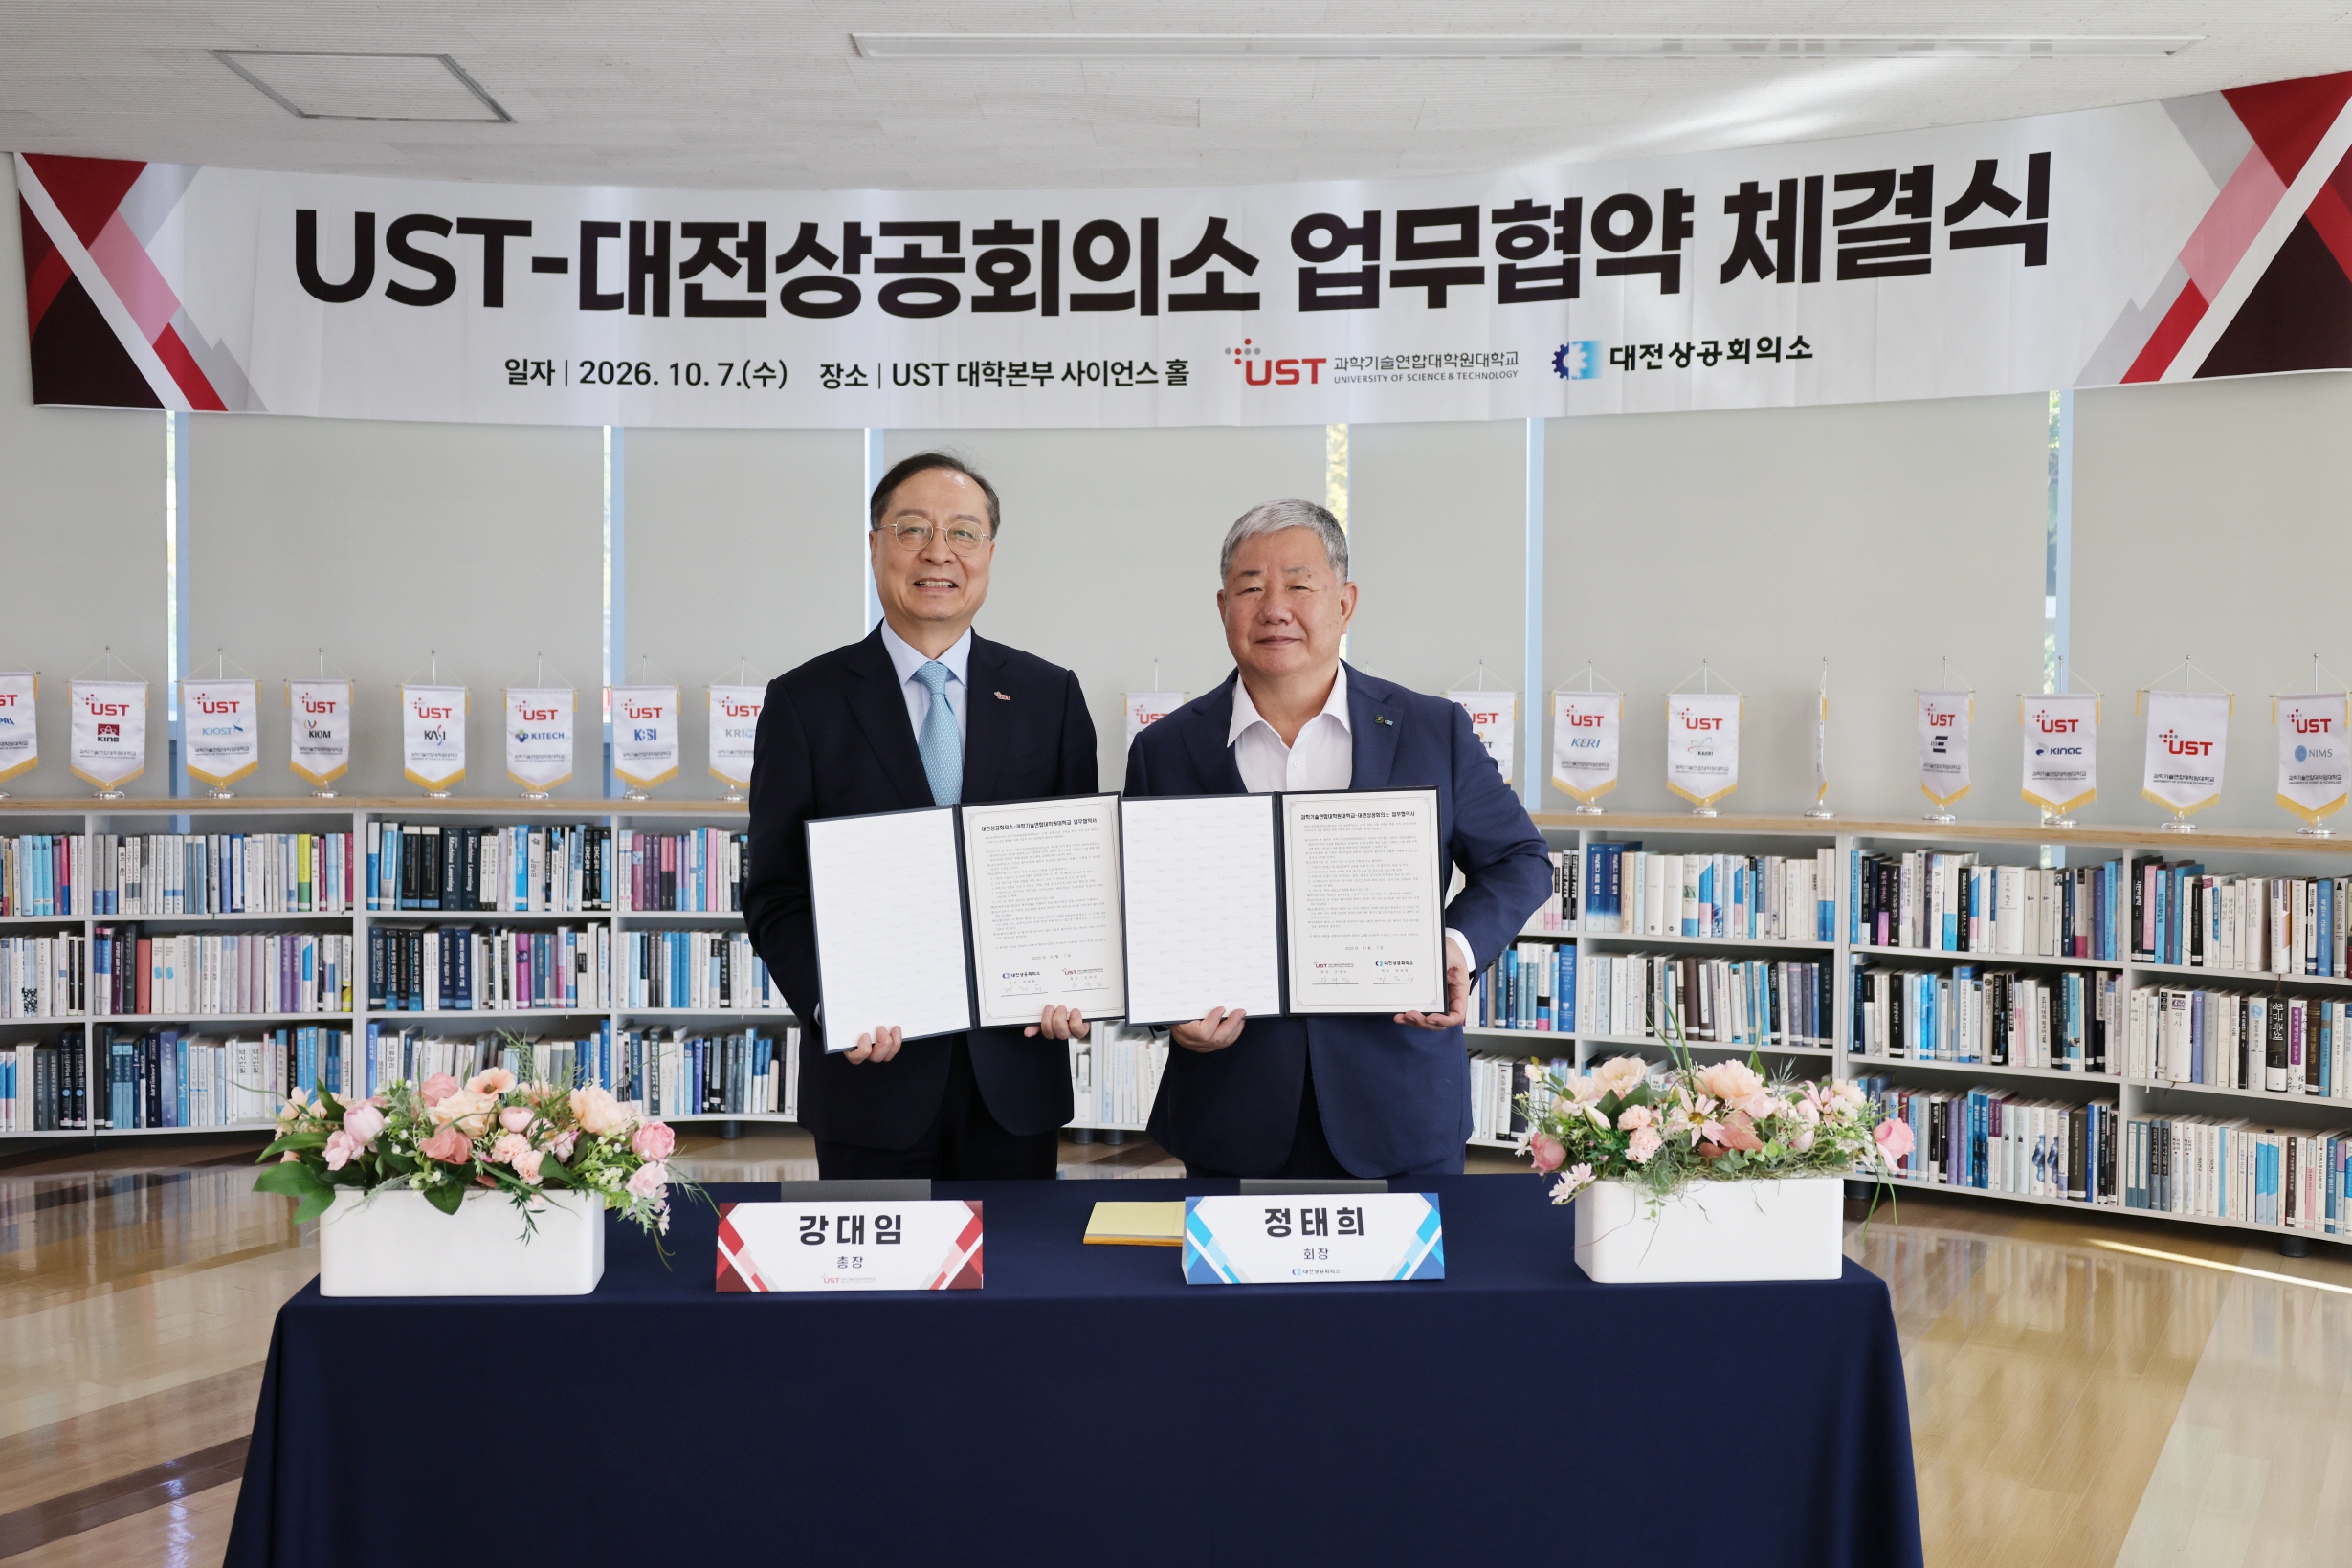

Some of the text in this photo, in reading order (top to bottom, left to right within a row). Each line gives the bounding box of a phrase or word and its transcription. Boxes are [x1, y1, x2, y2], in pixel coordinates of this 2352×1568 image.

[296, 152, 2051, 319] UST-대전상공회의소 업무협약 체결식
[1334, 351, 1519, 371] 과학기술연합대학원대학교
[1610, 336, 1813, 372] 대전상공회의소
[505, 359, 788, 390] 일자 2026. 10. 7.(수)
[820, 358, 1189, 389] 장소 UST 대학본부 사이언스 홀
[1246, 359, 1327, 386] UST
[1334, 369, 1519, 385] UNIVERSITY OF SCIENCE & TECHNOLOGY
[91, 703, 130, 717] UST
[202, 700, 240, 715] UST
[305, 701, 337, 715] UST
[418, 706, 453, 719] UST
[629, 707, 663, 718] UST
[522, 709, 559, 721] UST
[1570, 715, 1605, 728] UST
[1929, 713, 1956, 727] UST
[1686, 717, 1723, 731] UST
[2041, 718, 2079, 733] UST
[2296, 718, 2332, 734] UST
[202, 726, 233, 737] KIOST
[308, 730, 332, 740] KIOM
[531, 731, 566, 740] KITECH
[1570, 738, 1601, 749] KERI
[2168, 740, 2214, 757] UST
[2308, 748, 2333, 758] NIMS
[530, 858, 540, 878] Java
[1264, 1206, 1365, 1238] 정태희
[800, 1214, 901, 1246] 강대임
[1303, 1248, 1329, 1260] 회장
[837, 1255, 864, 1269] 총장
